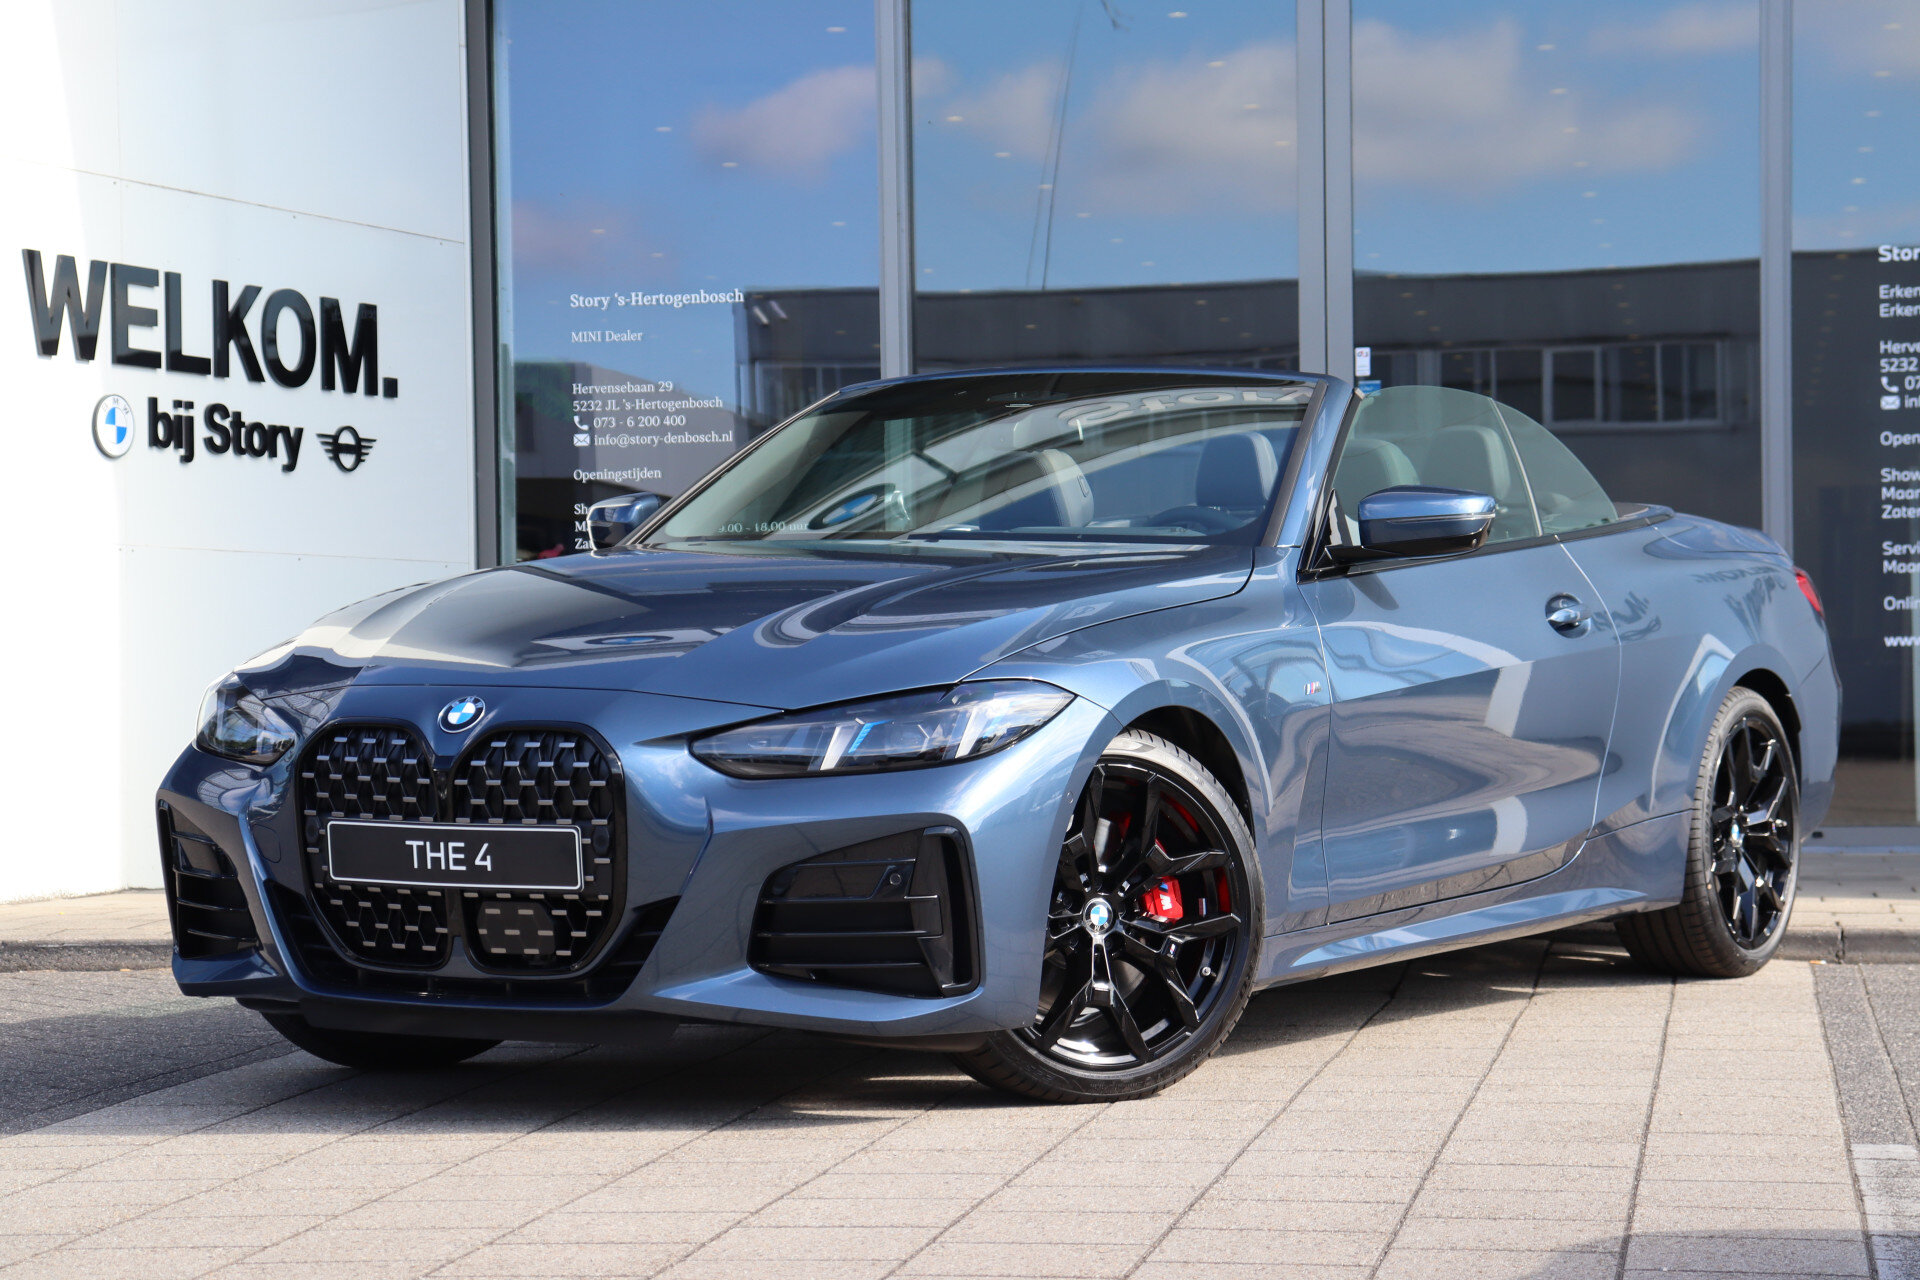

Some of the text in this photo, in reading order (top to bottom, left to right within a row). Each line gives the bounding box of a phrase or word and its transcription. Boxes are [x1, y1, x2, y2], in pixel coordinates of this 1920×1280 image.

[569, 288, 744, 310] Story 's-Hertogenbosch
[22, 248, 398, 399] WELKOM.
[571, 329, 642, 343] MINI Dealer
[1880, 356, 1918, 373] 5232
[572, 380, 673, 394] Hervensebaan 29
[572, 396, 724, 412] 5232 JL 's-Hertogenbosch
[593, 416, 616, 429] 073
[626, 416, 635, 427] 6
[637, 415, 661, 427] 200
[663, 414, 687, 426] 400
[147, 396, 304, 473] bij Story
[594, 430, 734, 447] info@story-denbosch.nl
[573, 468, 662, 482] Openingstijden
[574, 503, 590, 515] Sh
[405, 841, 492, 871] THE 4
